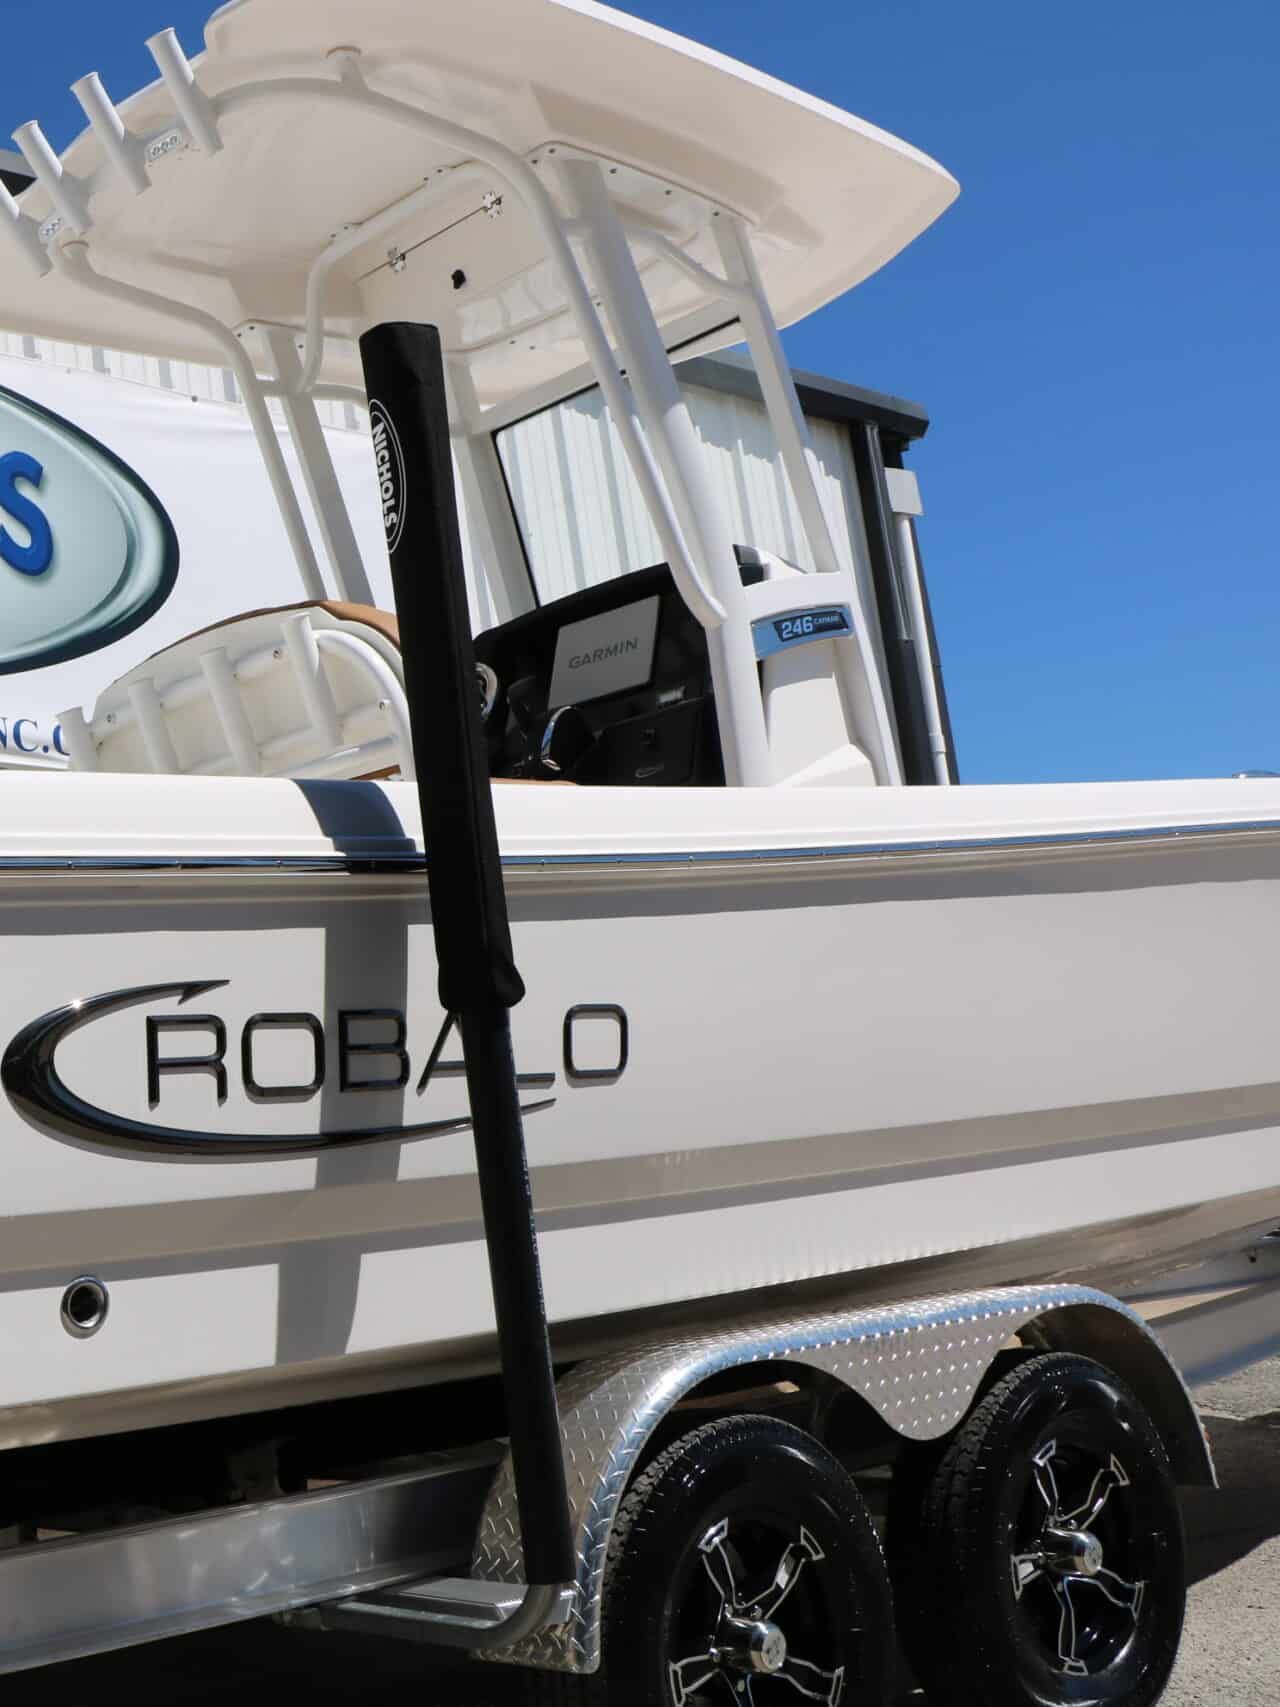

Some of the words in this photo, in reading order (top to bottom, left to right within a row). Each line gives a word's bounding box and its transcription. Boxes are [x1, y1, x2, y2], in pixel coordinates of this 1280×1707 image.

[372, 421, 398, 528] NICHOLS
[781, 616, 813, 638] 246
[568, 637, 639, 669] GARMIN
